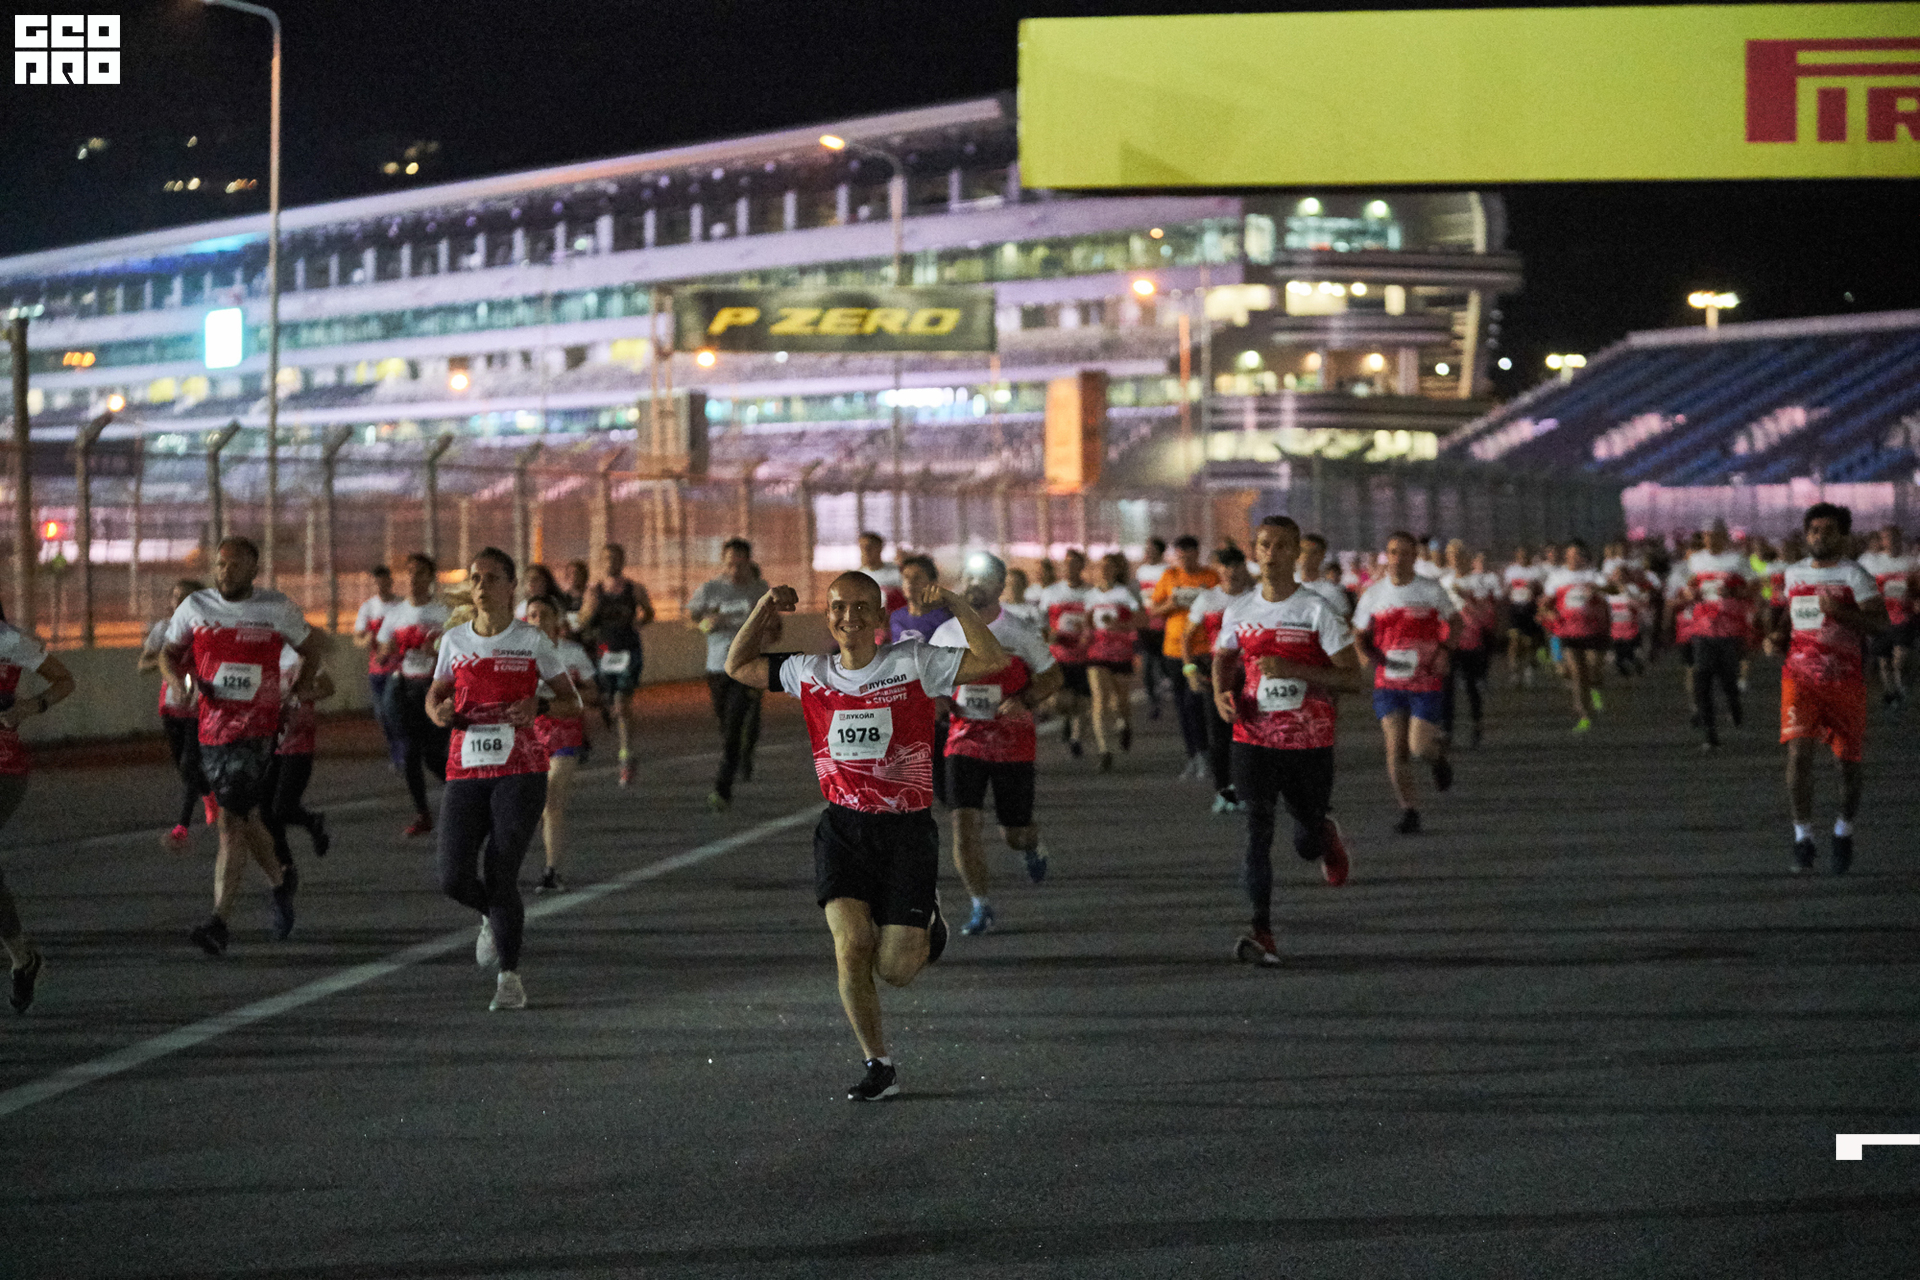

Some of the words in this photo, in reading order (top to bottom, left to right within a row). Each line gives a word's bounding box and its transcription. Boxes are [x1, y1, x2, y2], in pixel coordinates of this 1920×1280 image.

[707, 307, 760, 336] P
[769, 307, 962, 336] ZERO
[223, 676, 252, 688] 1216
[869, 674, 907, 690] ЛУКОЙЛ
[1265, 685, 1299, 697] 1429
[873, 693, 907, 704] СПОРТЕ
[838, 727, 881, 744] 1978
[470, 739, 502, 752] 1168
